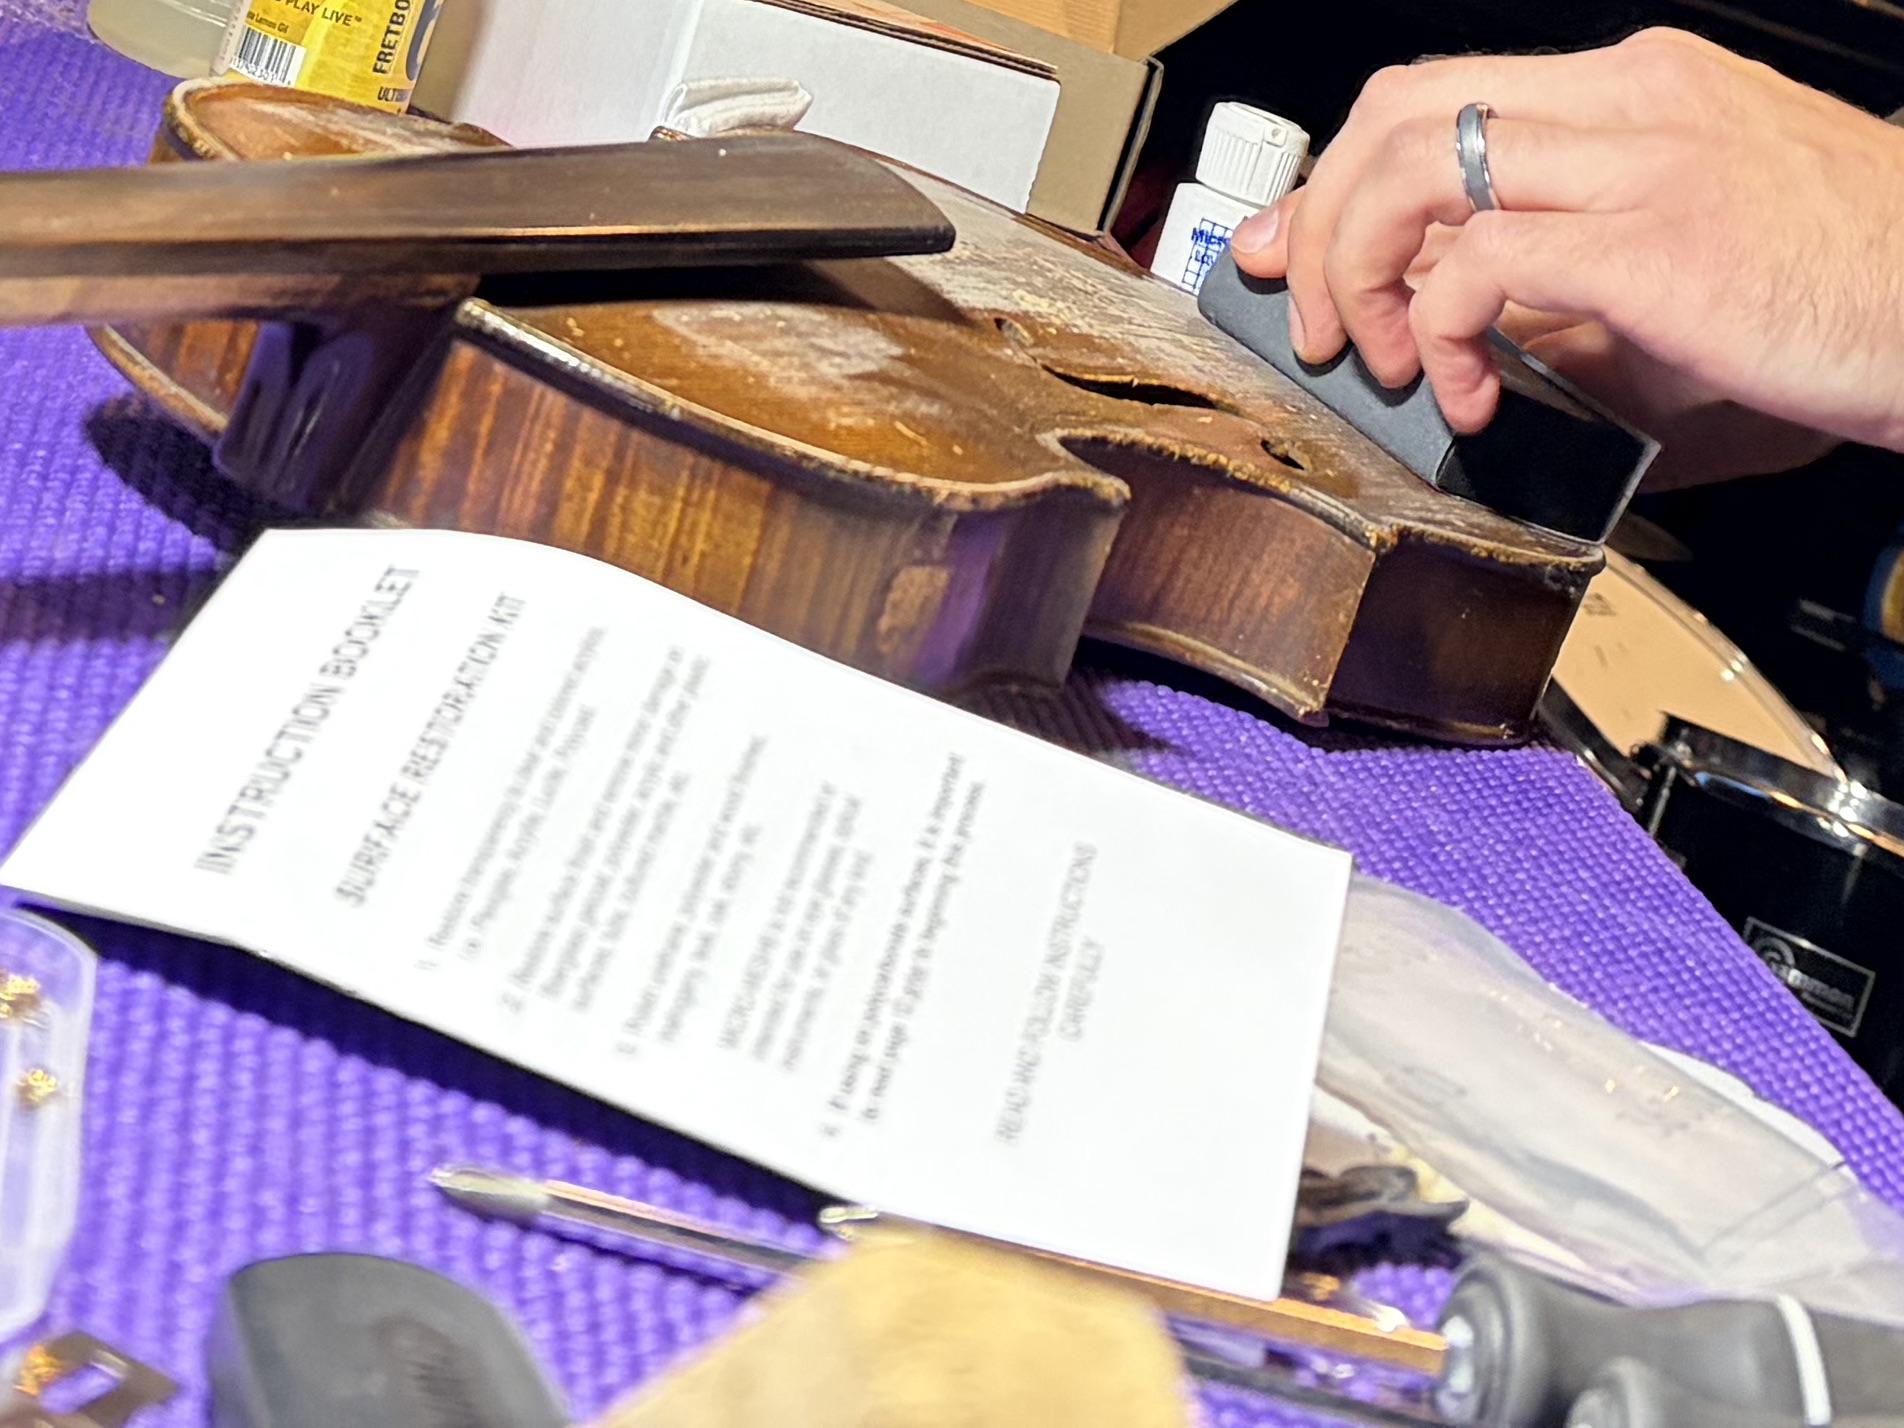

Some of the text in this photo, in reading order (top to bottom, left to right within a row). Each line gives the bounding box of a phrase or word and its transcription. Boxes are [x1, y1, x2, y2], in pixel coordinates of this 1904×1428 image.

[186, 560, 422, 878] INSTRUCTION BOOKLET
[322, 780, 428, 908] SURFACE
[390, 626, 514, 786] RESTORATION
[482, 591, 529, 629] KIT
